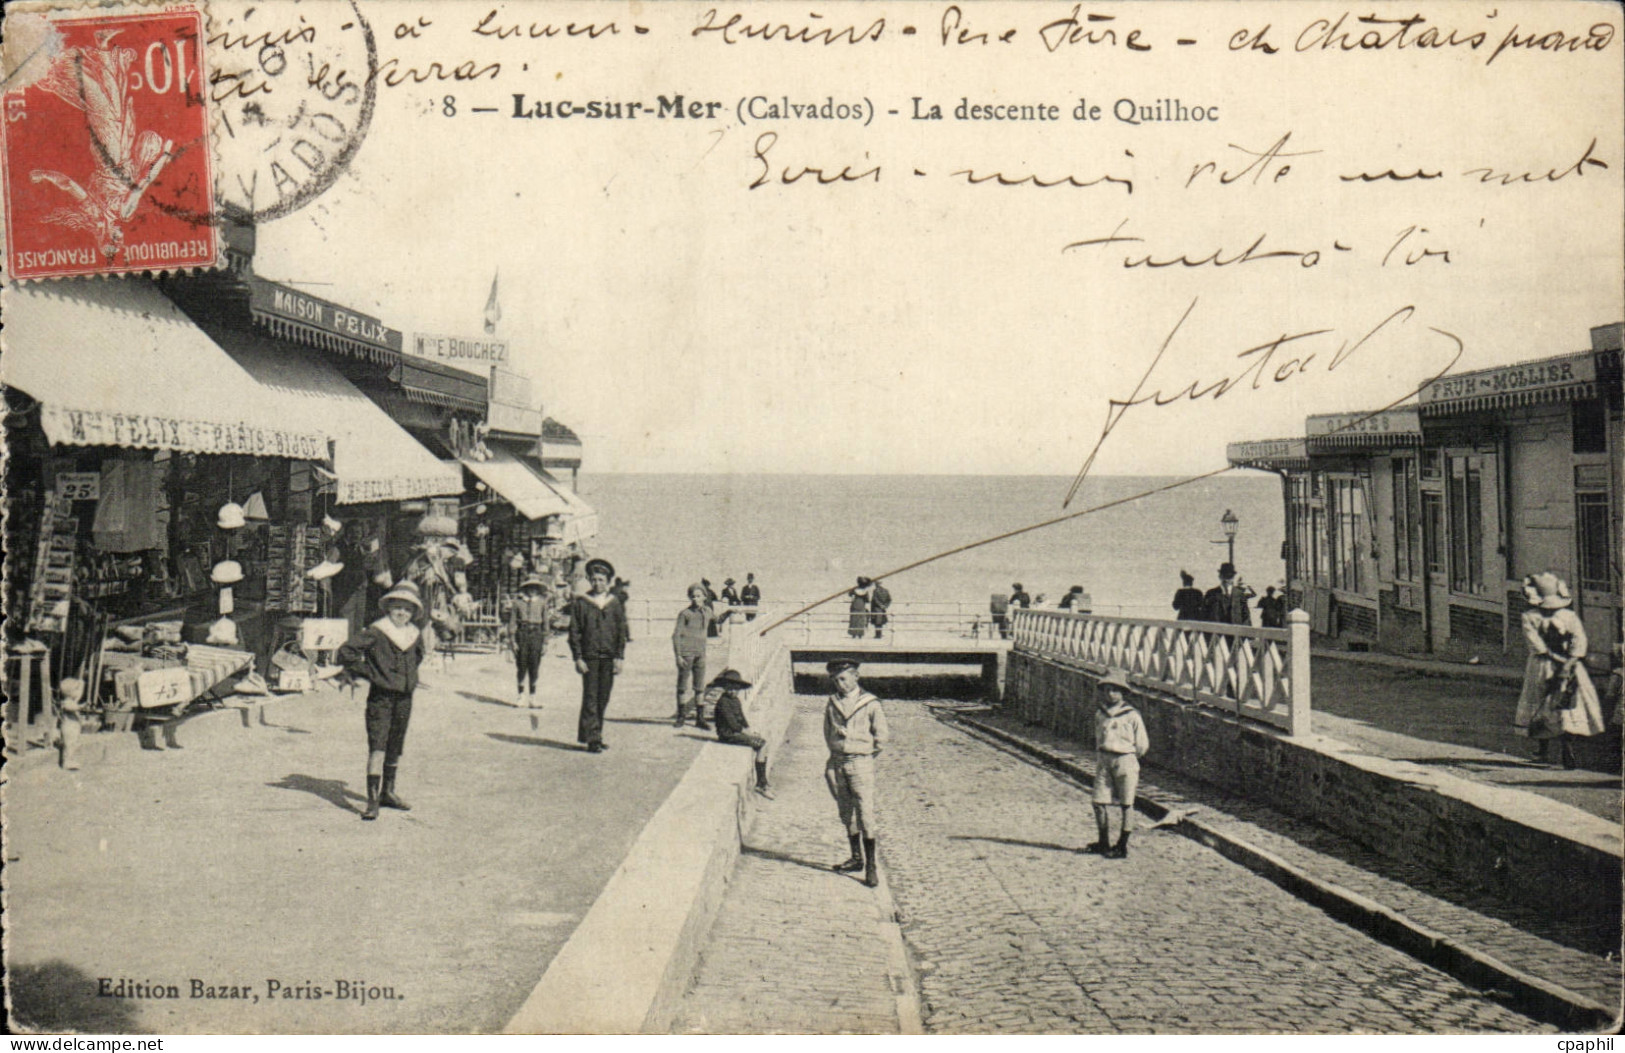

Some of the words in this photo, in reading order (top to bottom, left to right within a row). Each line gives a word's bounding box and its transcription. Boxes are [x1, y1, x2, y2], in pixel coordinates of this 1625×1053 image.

[16, 246, 97, 269] FRANÇAISE
[122, 238, 209, 263] REPUBLIQUE
[274, 289, 324, 323] MAISON
[334, 310, 389, 344] FELIX
